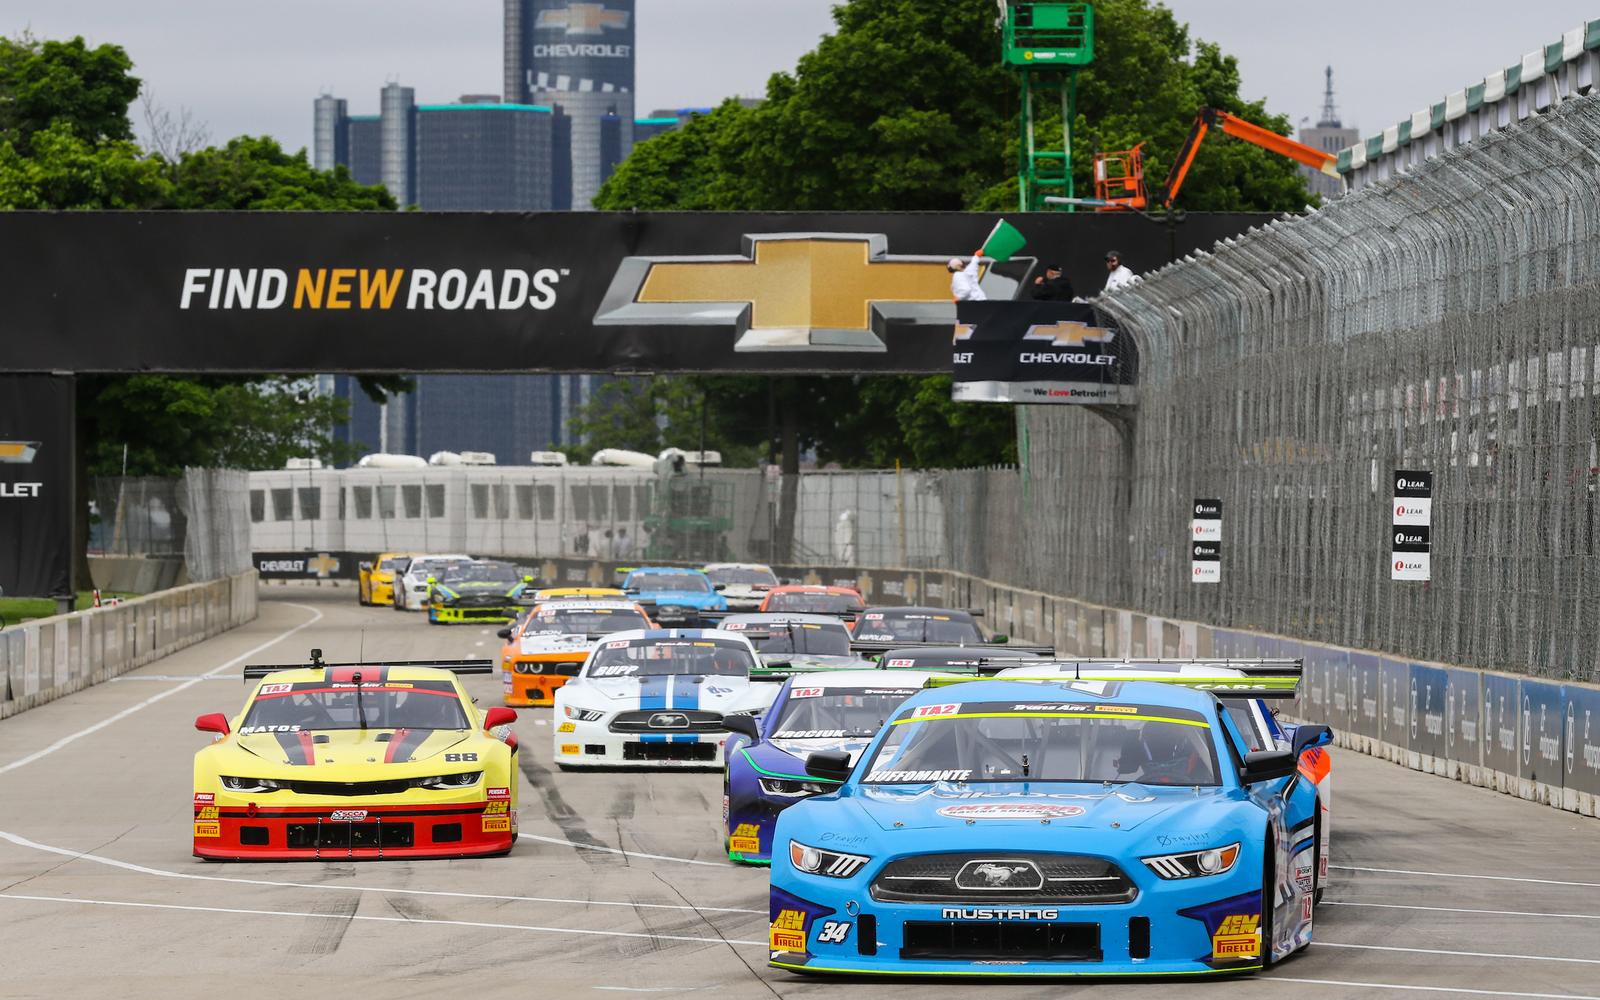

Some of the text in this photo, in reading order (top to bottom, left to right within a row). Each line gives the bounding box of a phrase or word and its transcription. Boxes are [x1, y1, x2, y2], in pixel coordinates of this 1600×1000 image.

[533, 44, 631, 58] CHEVROLET
[180, 268, 288, 310] FIND
[293, 268, 404, 310] NEW
[1019, 352, 1116, 366] CHEVROLET
[1033, 388, 1047, 396] We
[1048, 388, 1070, 397] Love
[891, 659, 911, 667] TA2
[265, 684, 290, 693] TA2
[795, 688, 820, 697] TA2
[918, 704, 957, 717] TA2
[1012, 704, 1088, 712] Trans Am
[241, 725, 301, 734] MATOS
[771, 729, 846, 739] PROCIUK
[444, 752, 478, 762] 88
[864, 769, 973, 783] BUFFOMANTE
[196, 825, 218, 835] PIRELLI
[484, 820, 507, 830] PIRELLI
[731, 823, 761, 837] AEM
[733, 839, 757, 850] PIRELLI
[772, 909, 807, 930] AEM
[942, 908, 1058, 920] MUSTANG
[1215, 914, 1260, 936] AEM
[817, 920, 851, 944] 34
[773, 932, 803, 950] PIRELLI
[1216, 938, 1256, 954] PIRELLI
